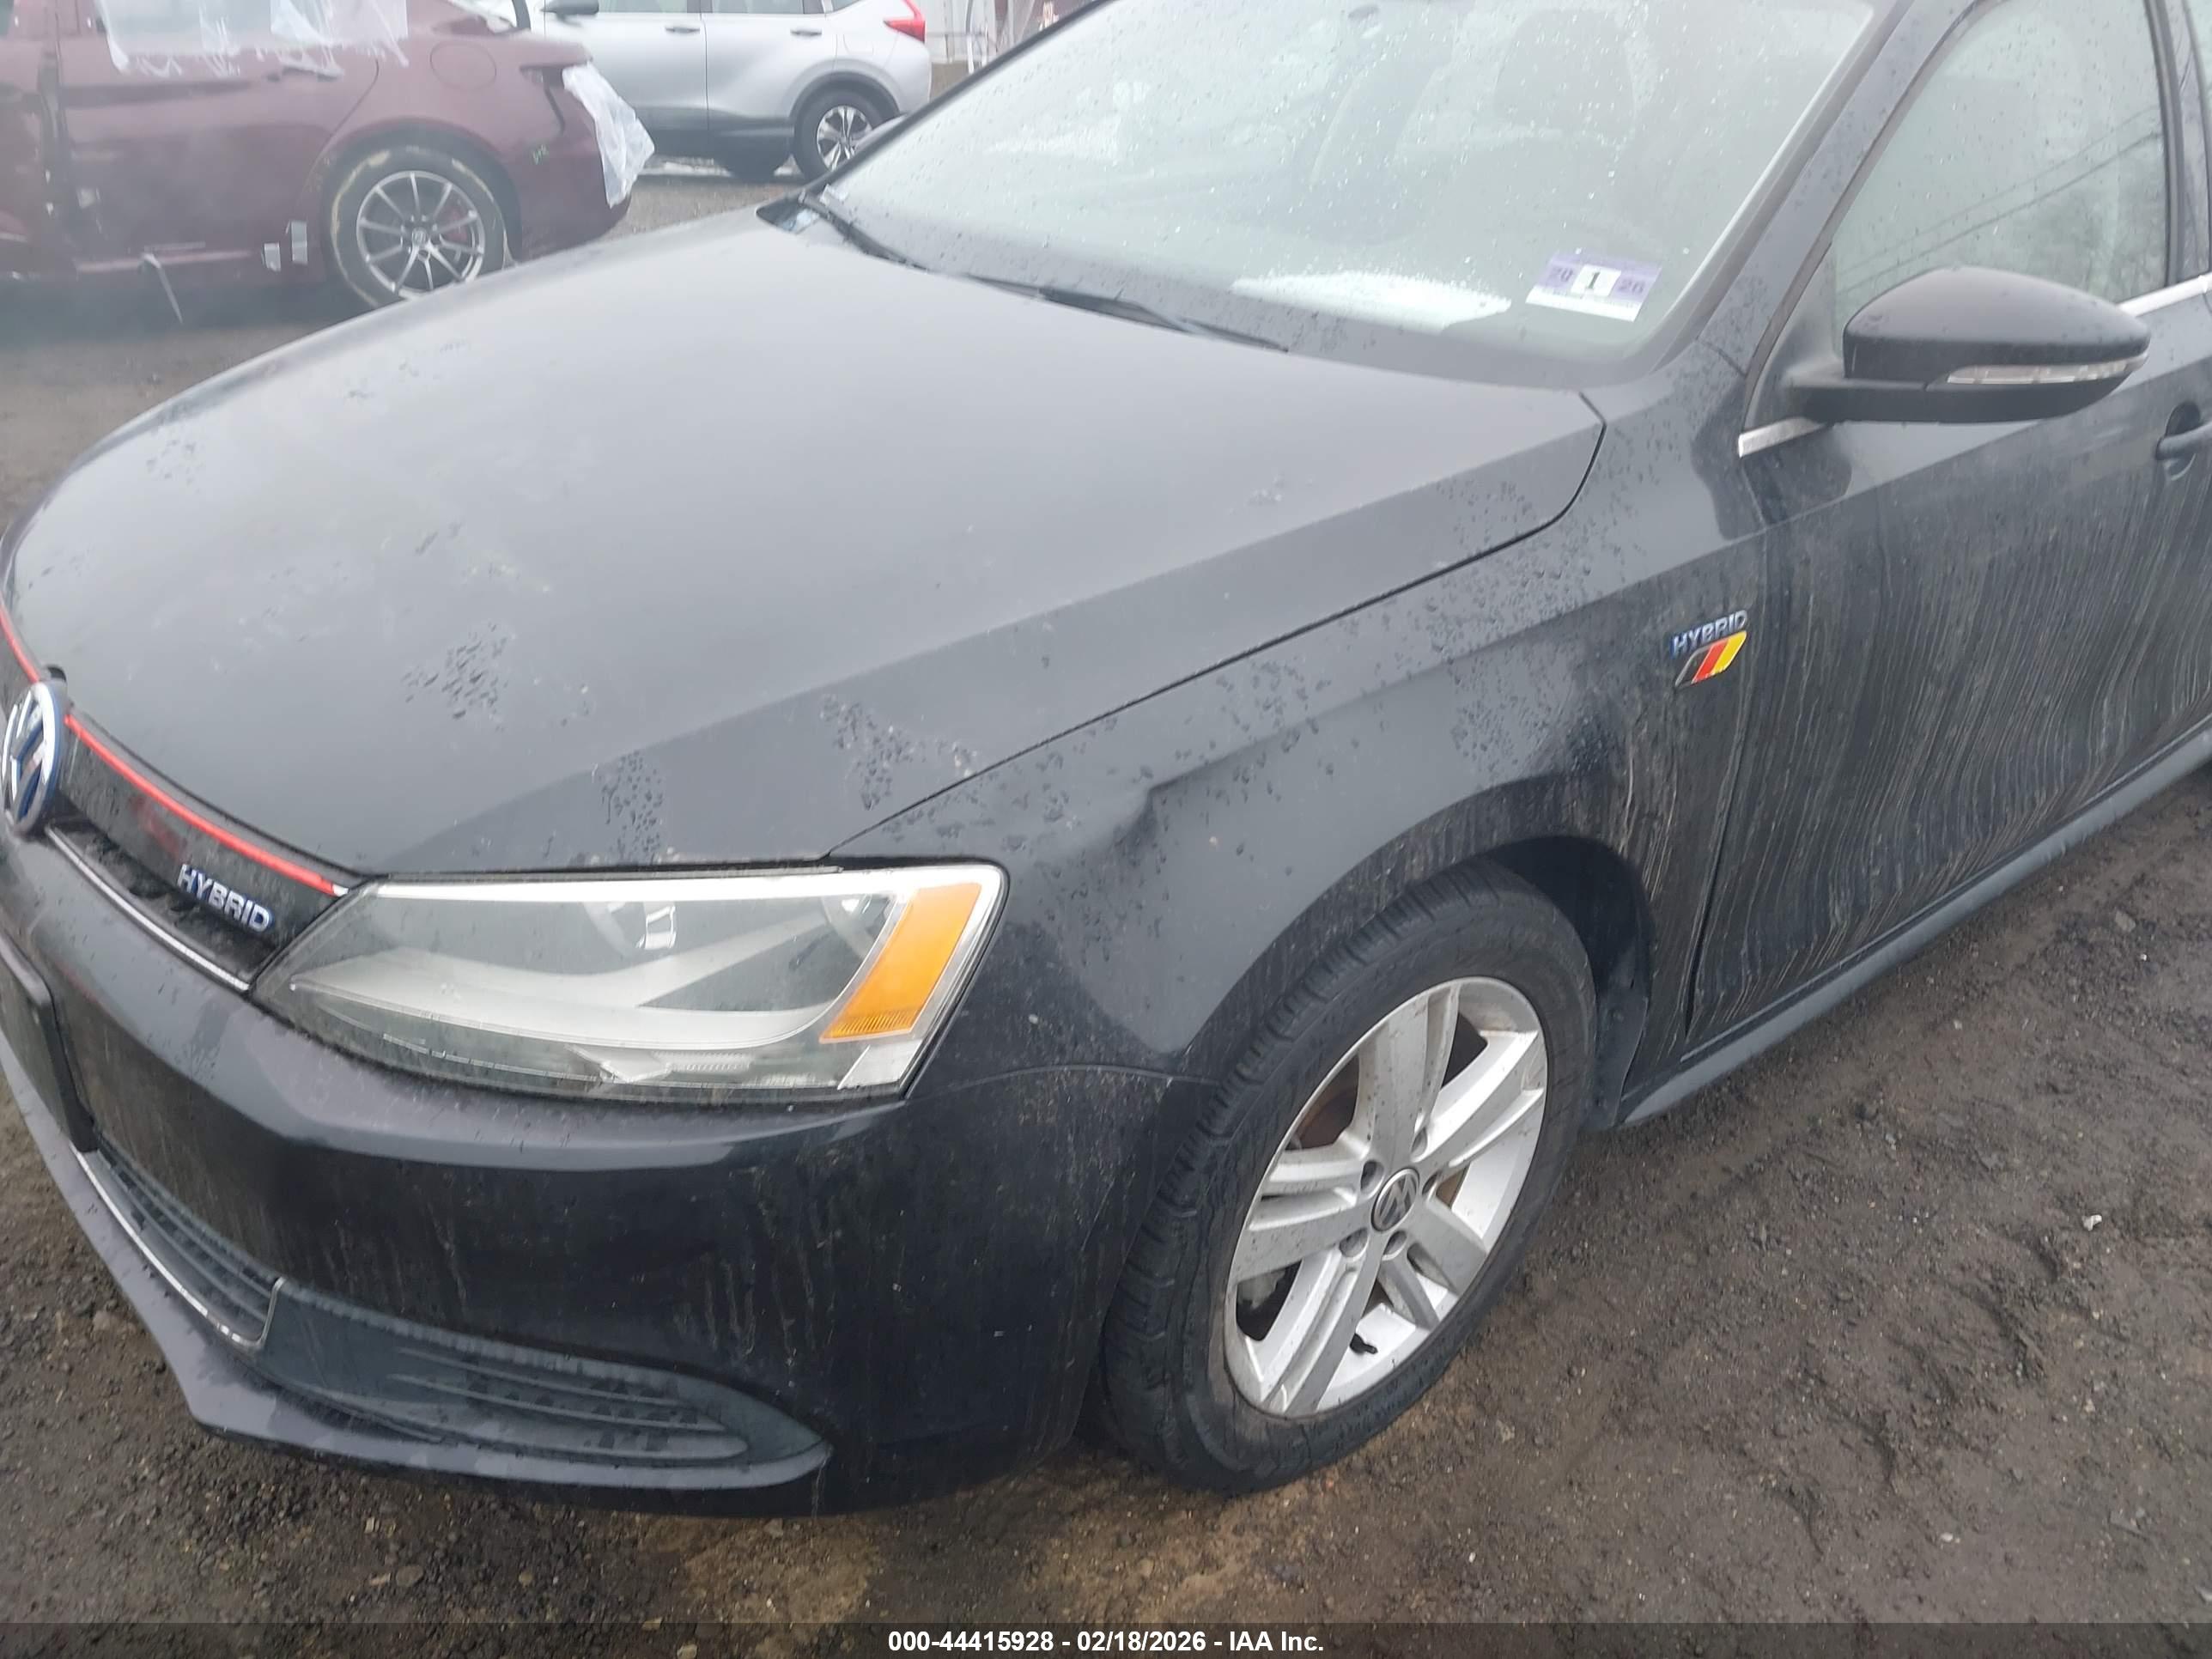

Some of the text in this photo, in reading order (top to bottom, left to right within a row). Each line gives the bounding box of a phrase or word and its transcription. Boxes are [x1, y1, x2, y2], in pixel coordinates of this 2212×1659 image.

[1587, 270, 1601, 289] 1
[1671, 610, 1747, 658] HYBRID
[177, 863, 272, 932] HYBRID
